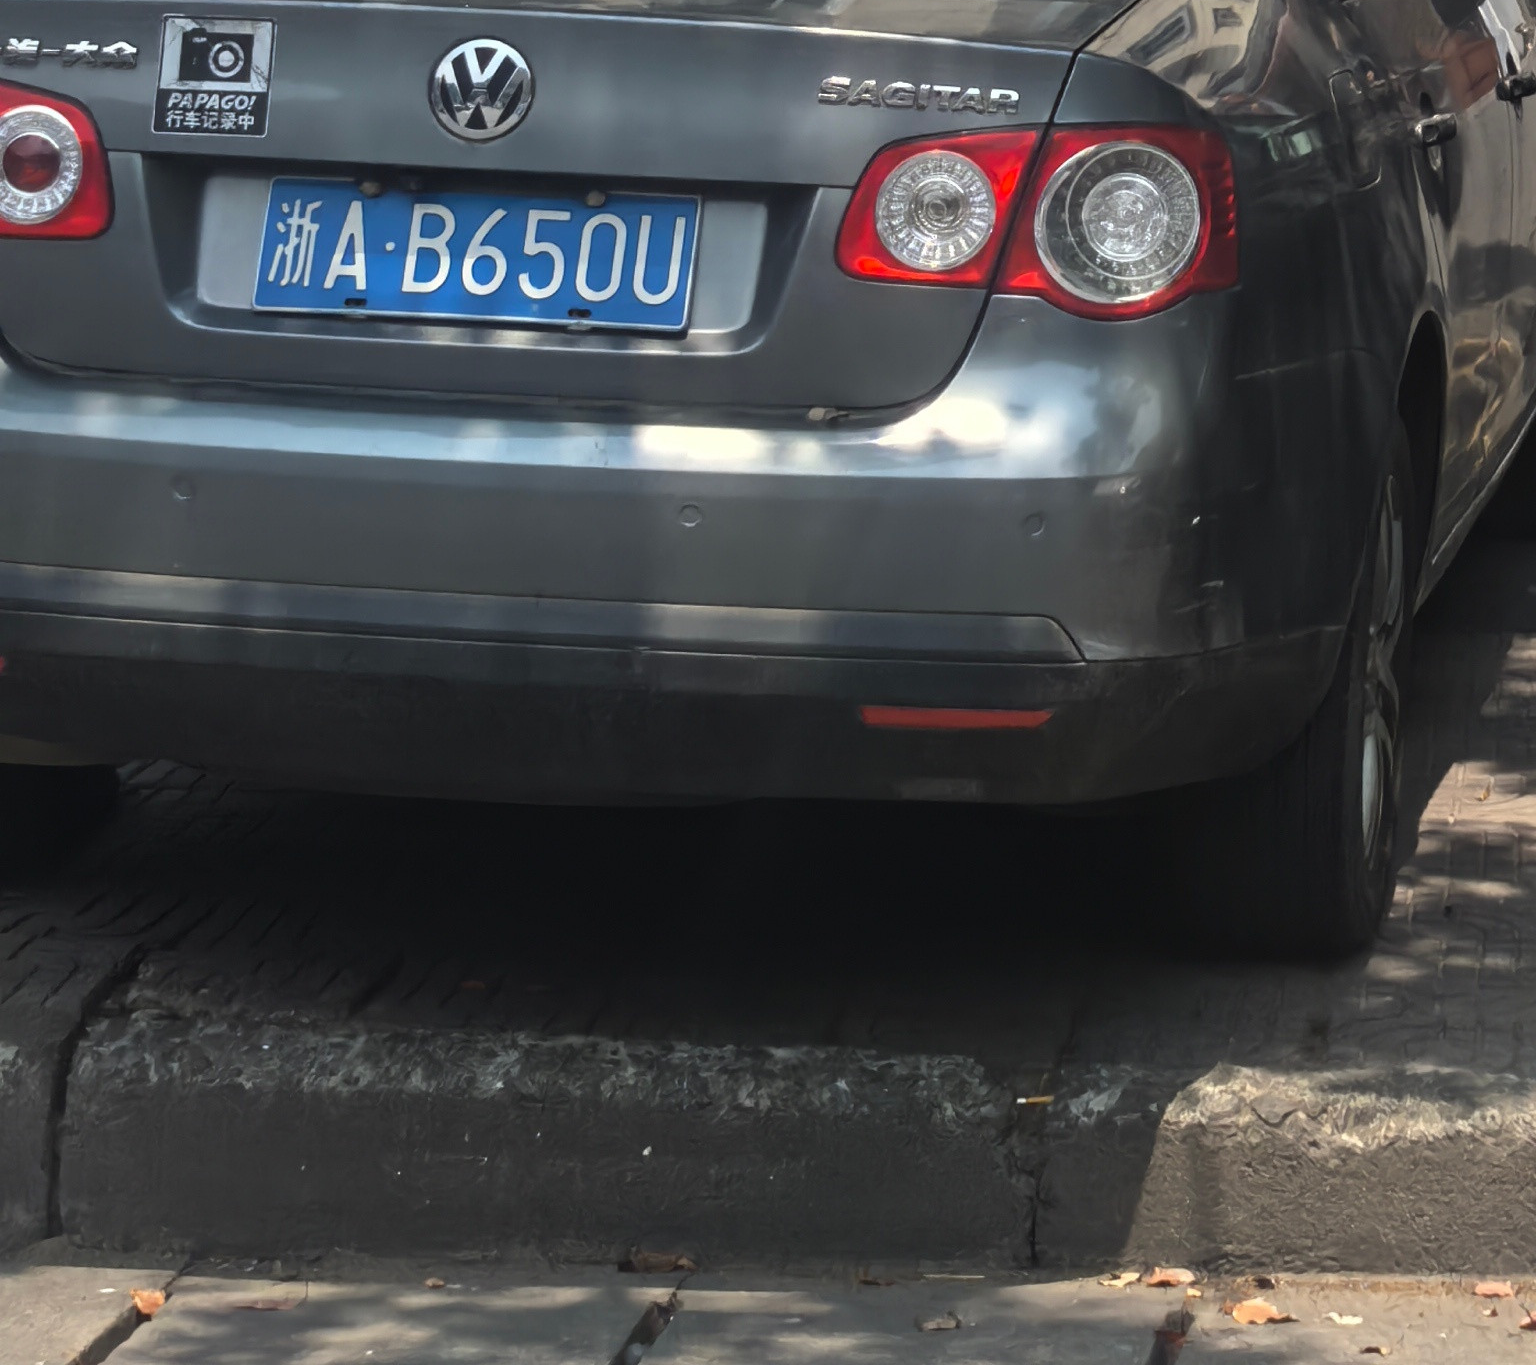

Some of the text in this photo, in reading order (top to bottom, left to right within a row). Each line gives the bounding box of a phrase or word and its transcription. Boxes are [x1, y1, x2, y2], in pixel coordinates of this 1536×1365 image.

[167, 92, 257, 111] PAPAGO!
[818, 76, 1019, 114] SAGITAR
[166, 113, 255, 130] 行车记录中
